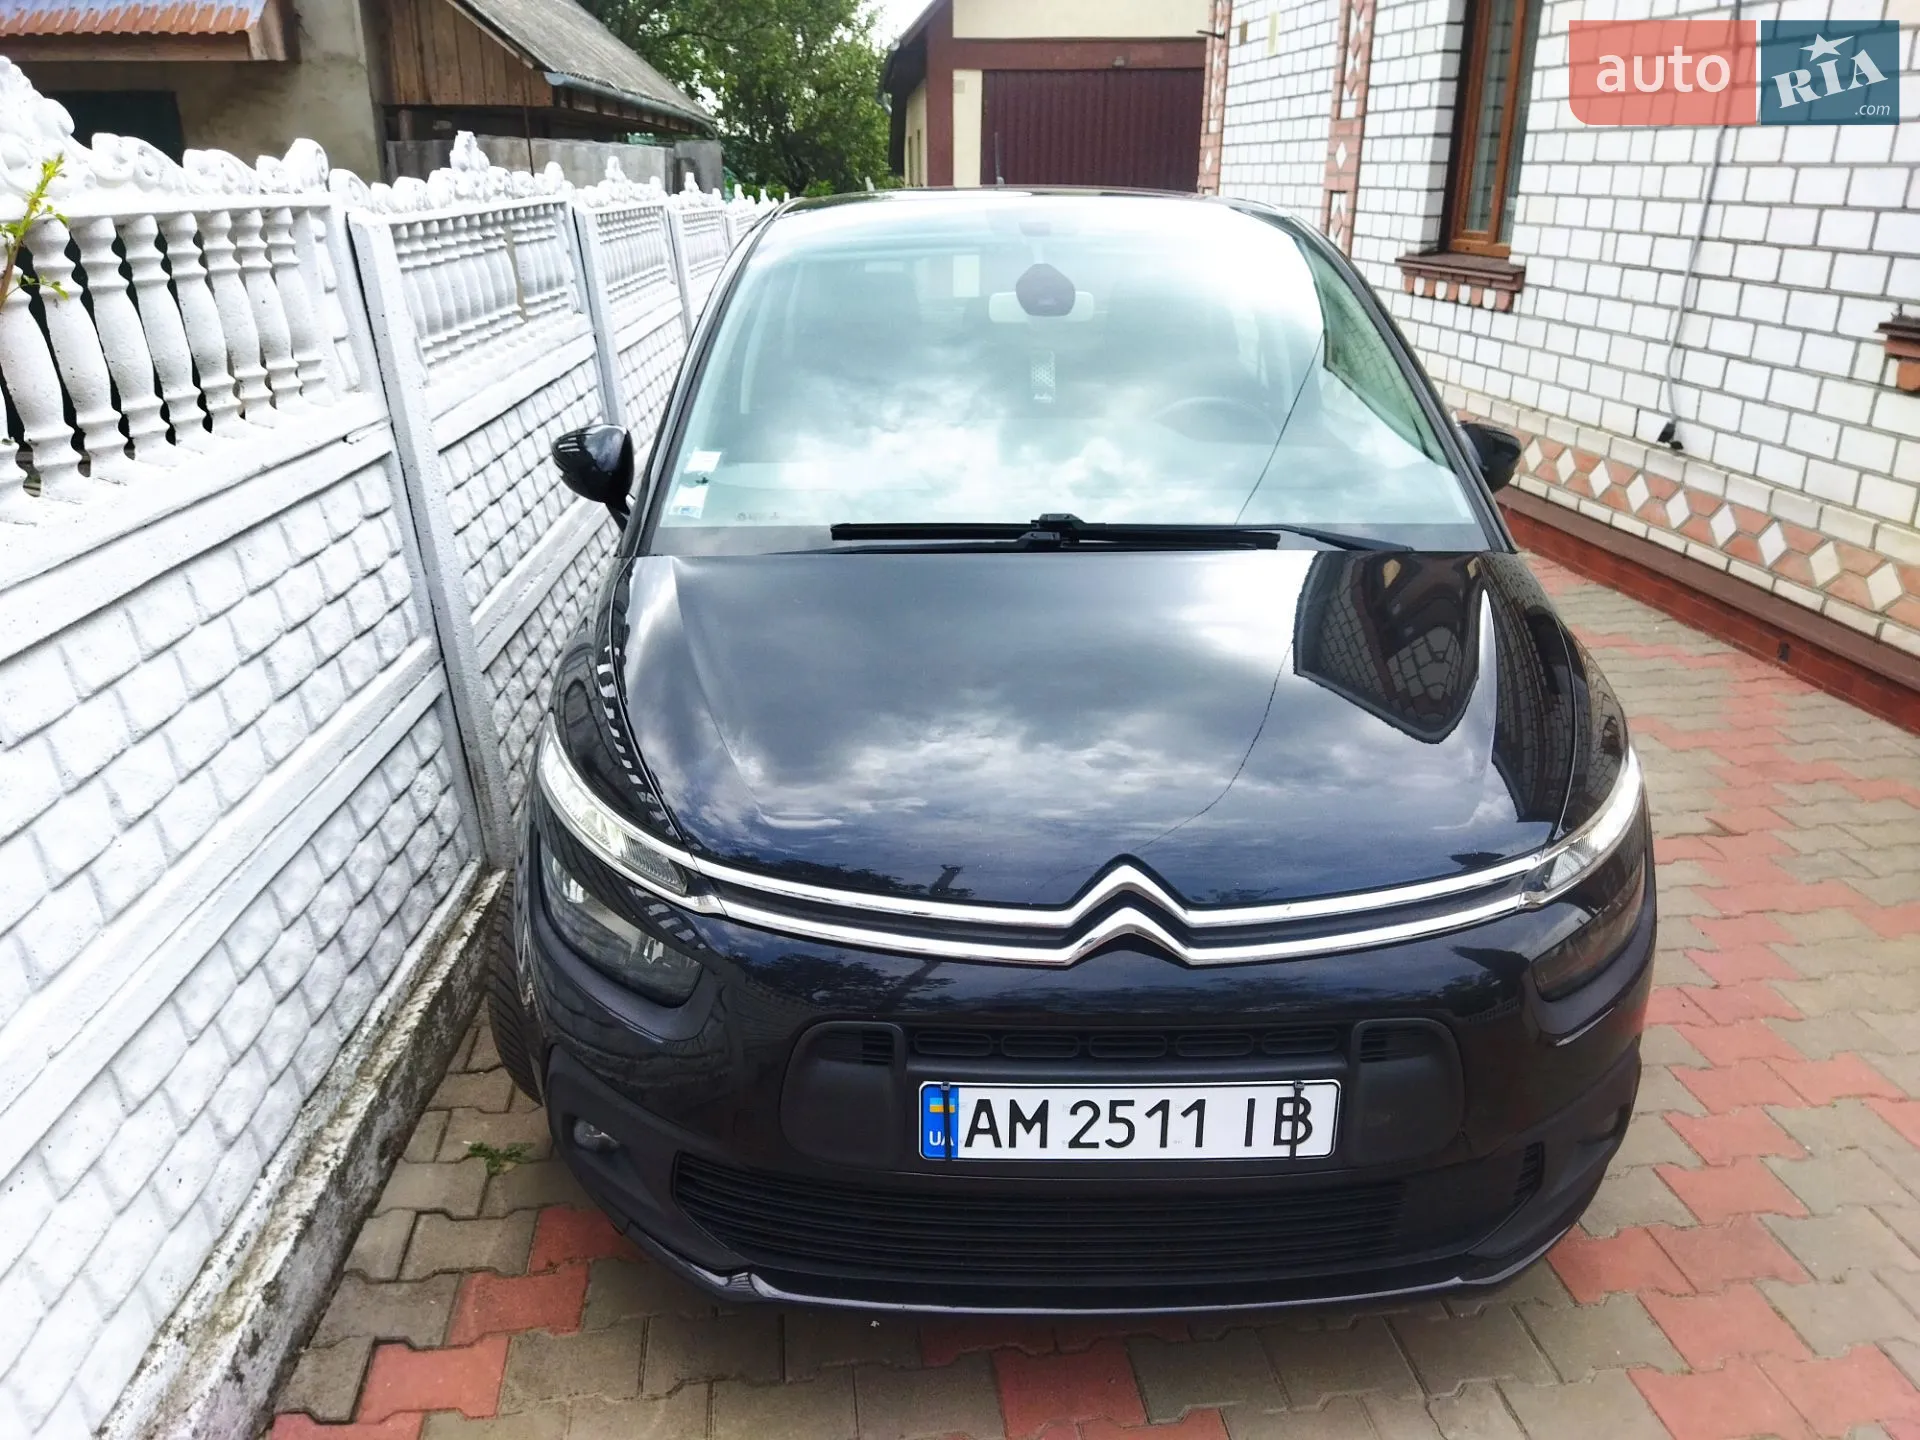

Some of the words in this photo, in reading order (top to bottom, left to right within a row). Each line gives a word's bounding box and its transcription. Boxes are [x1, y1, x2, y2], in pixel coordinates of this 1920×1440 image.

[964, 1098, 1048, 1149] AM
[1068, 1098, 1206, 1149] 2511
[1243, 1096, 1313, 1148] IB
